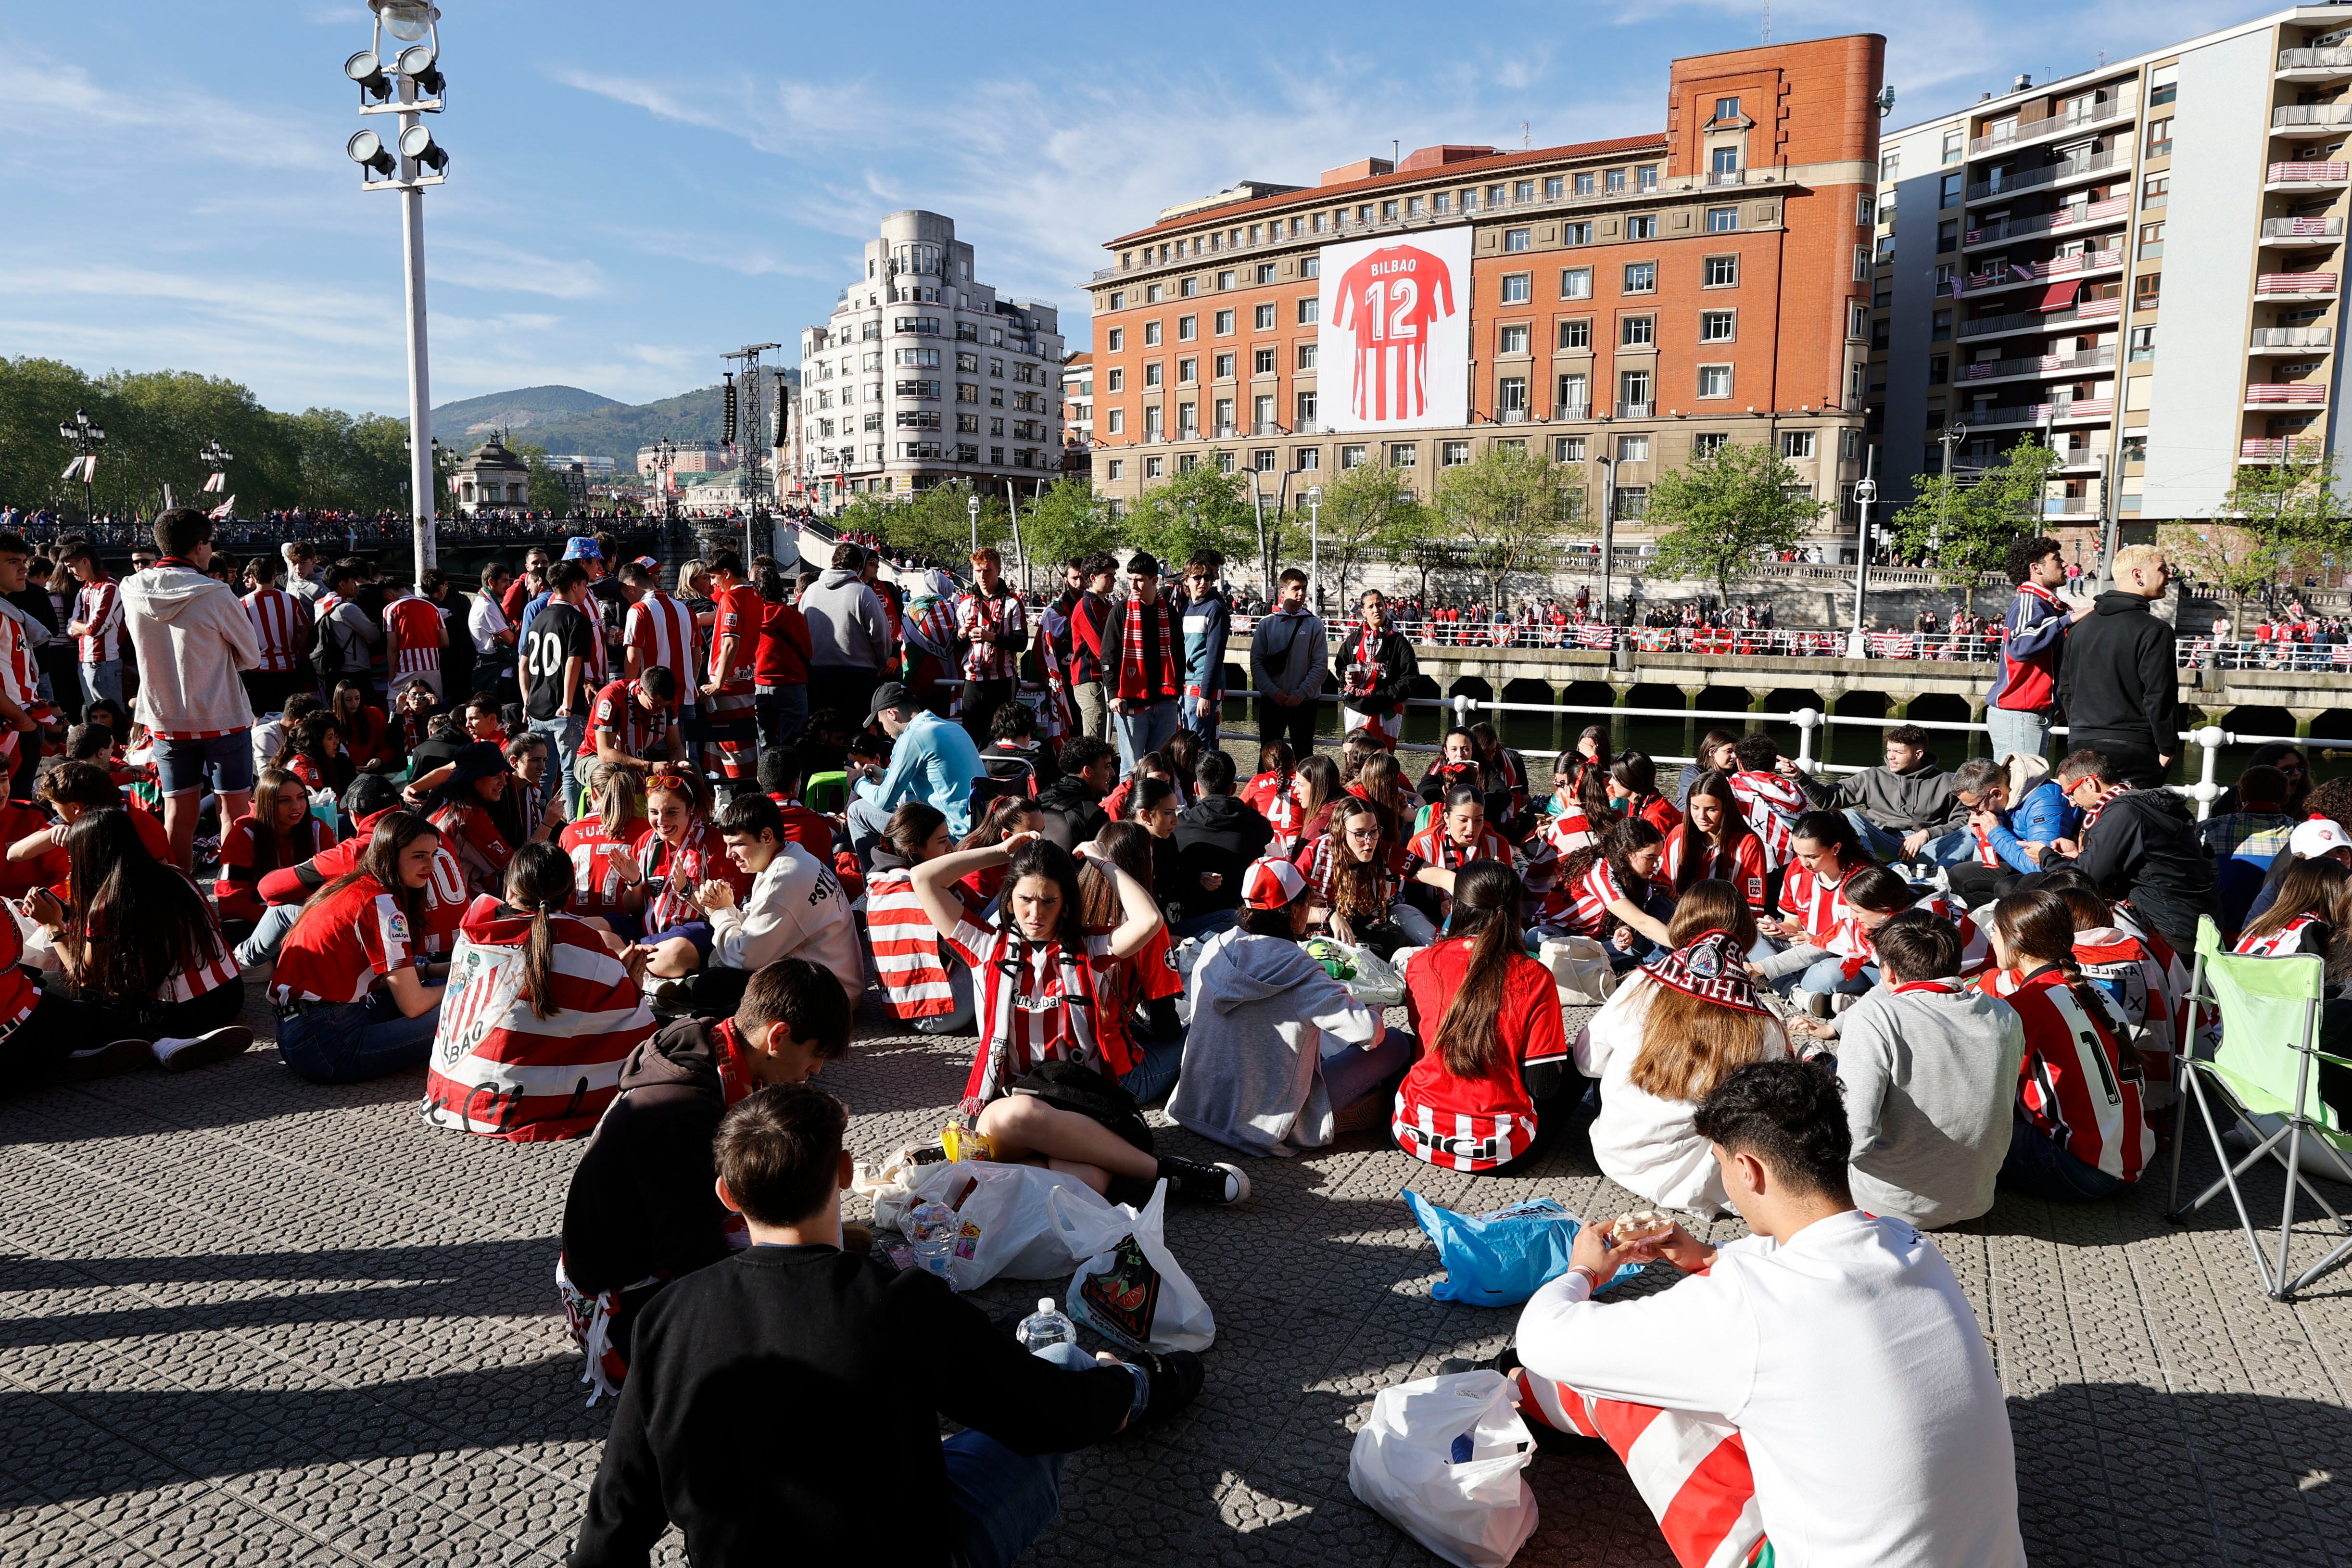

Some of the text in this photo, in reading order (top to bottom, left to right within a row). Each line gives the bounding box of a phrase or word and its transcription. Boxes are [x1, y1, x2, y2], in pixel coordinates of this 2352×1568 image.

[1371, 259, 1416, 277] BILBAO
[1365, 278, 1418, 341] 12
[528, 631, 562, 677] 20
[1267, 789, 1291, 828] 4
